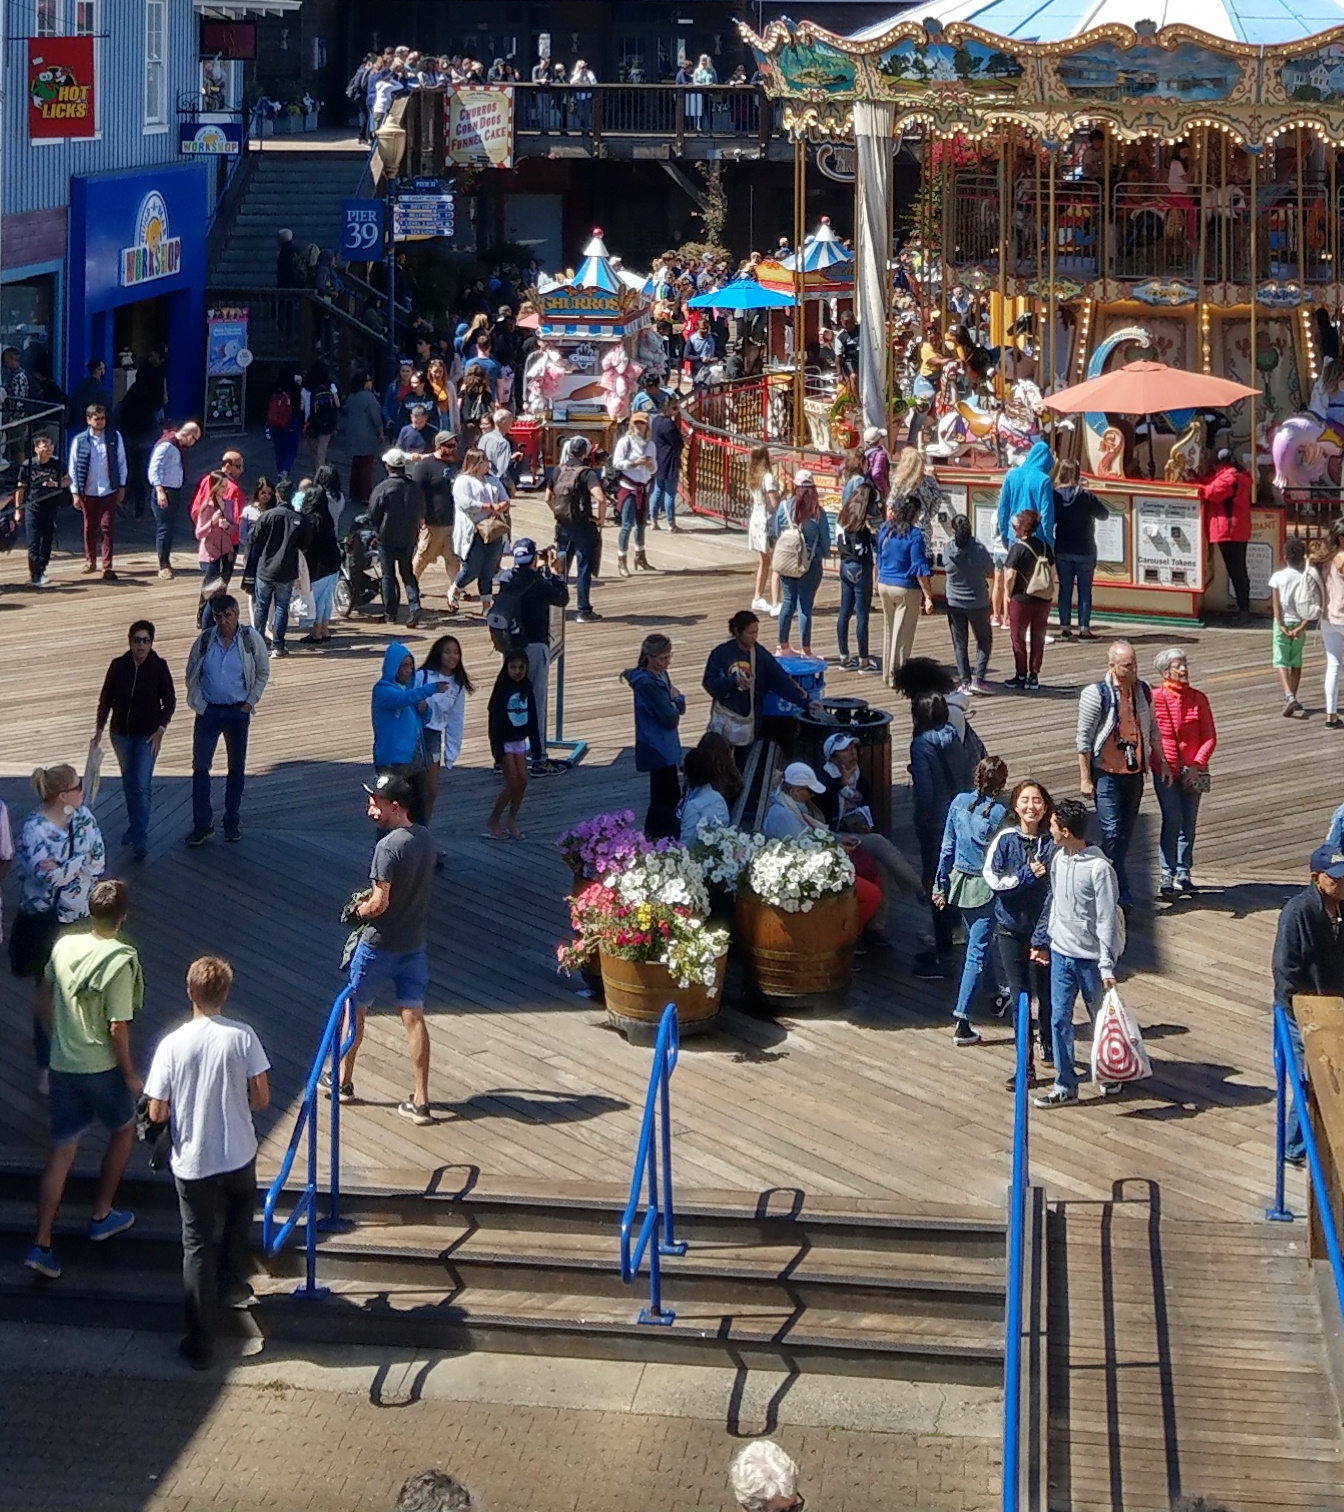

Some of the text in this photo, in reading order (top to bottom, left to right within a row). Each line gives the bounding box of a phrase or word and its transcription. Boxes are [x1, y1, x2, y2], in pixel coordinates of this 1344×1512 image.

[58, 85, 91, 101] HOT
[42, 103, 88, 119] LICKS
[459, 102, 497, 121] CHURROS
[455, 115, 502, 136] CORN DOGS
[451, 126, 507, 151] FUNNEL CAKE
[183, 141, 238, 153] WORKSHOP
[346, 210, 377, 222] PIER
[345, 222, 379, 249] 39
[126, 240, 181, 283] WORKSHOP
[541, 296, 620, 311] CHURROS
[1138, 556, 1196, 567] Carousel Tokens
